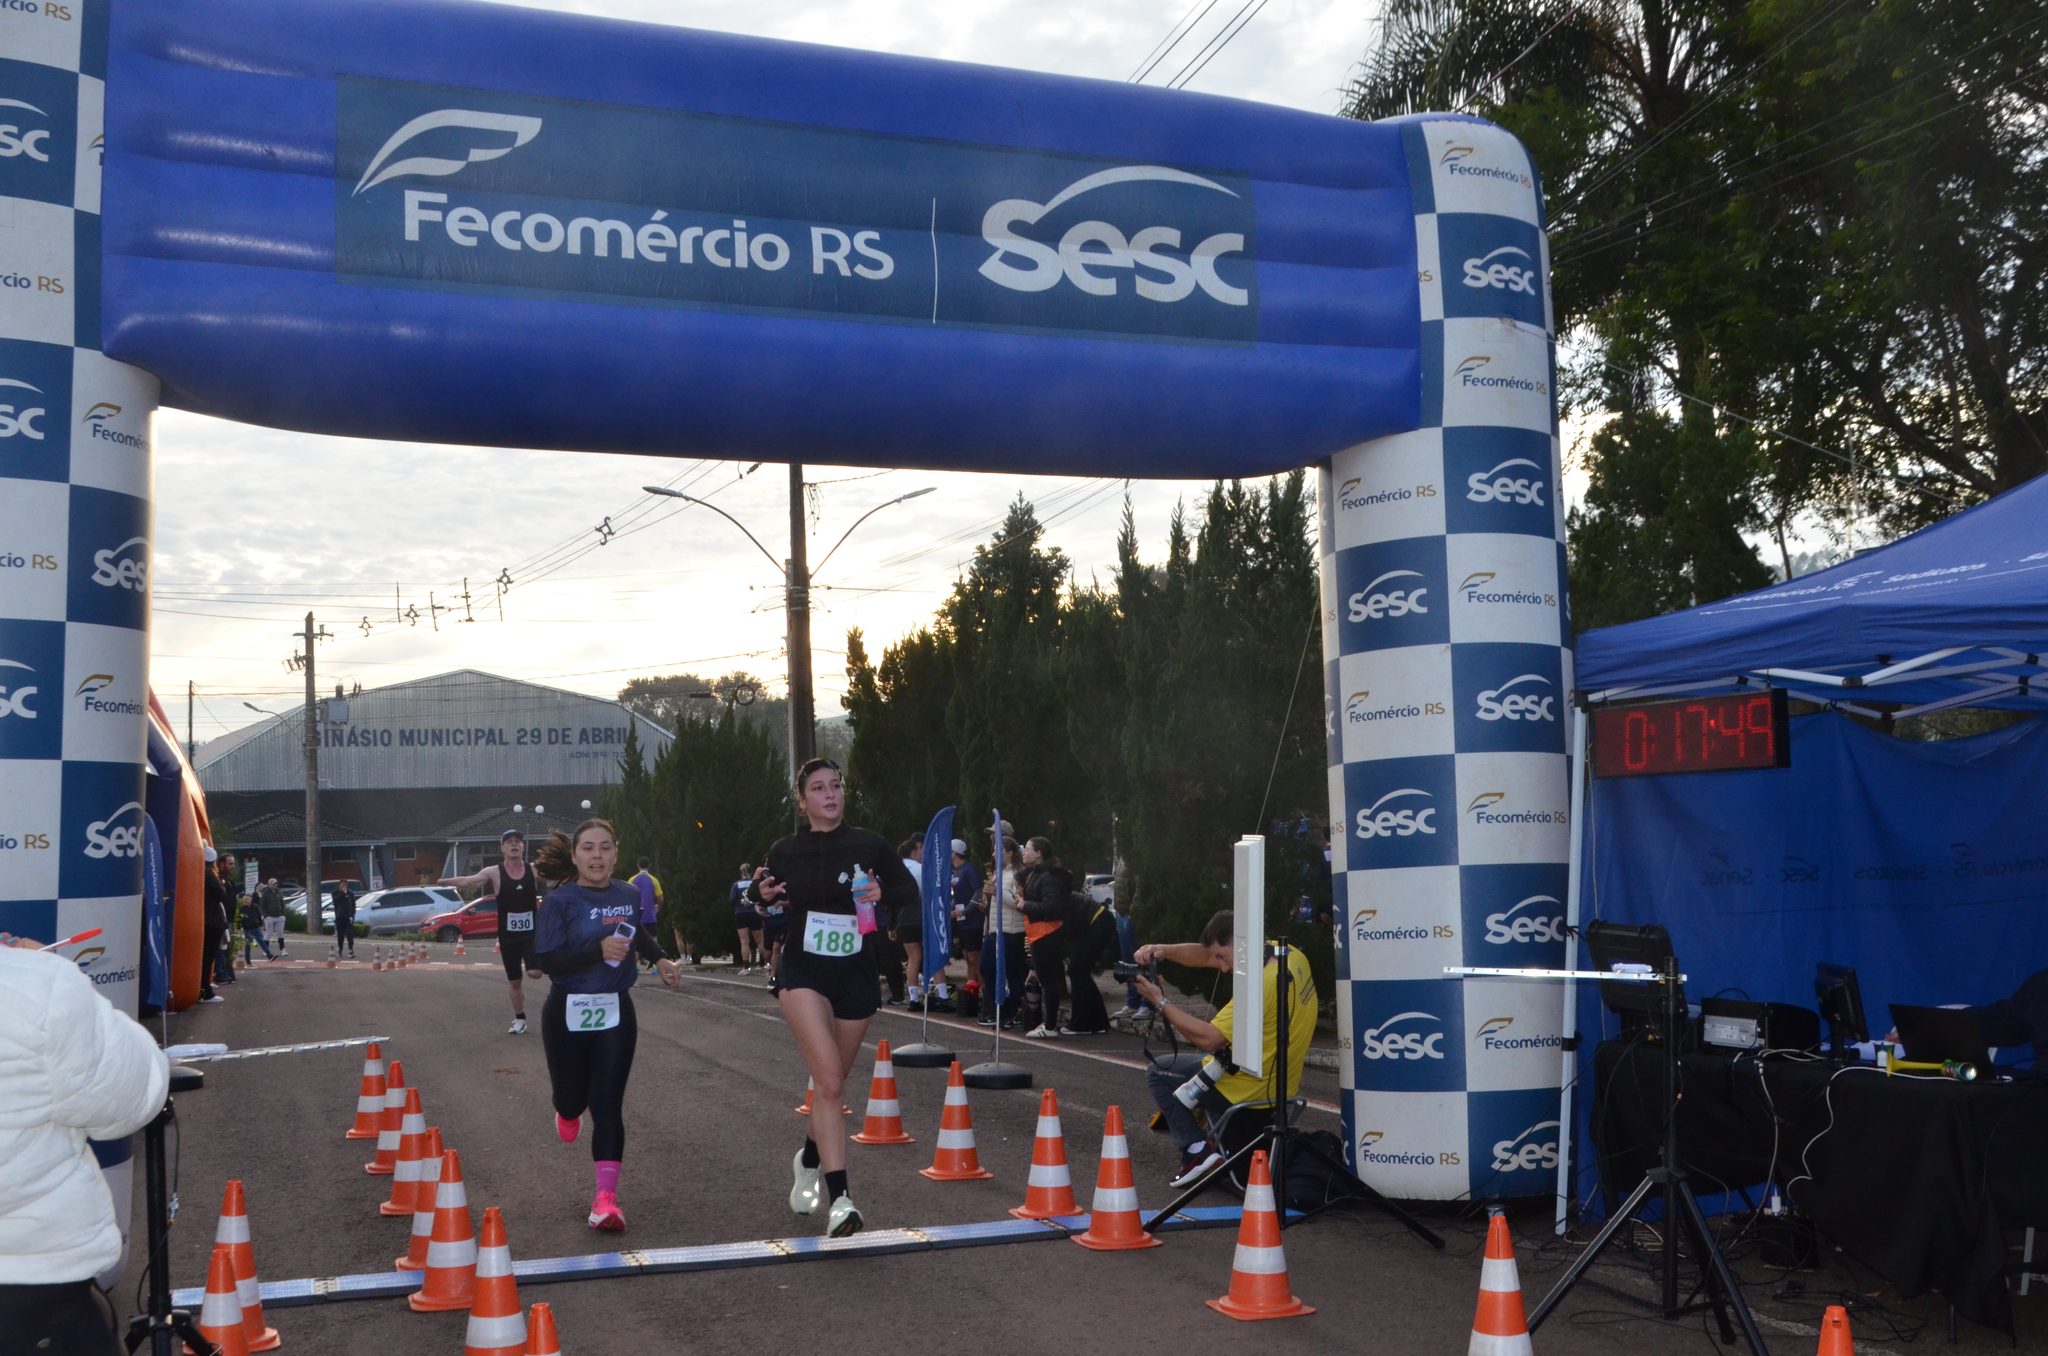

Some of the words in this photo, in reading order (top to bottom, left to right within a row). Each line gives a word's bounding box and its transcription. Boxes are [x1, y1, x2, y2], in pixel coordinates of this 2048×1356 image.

[44, 2, 72, 21] RS
[1450, 163, 1519, 184] Fecomércio
[1520, 175, 1532, 190] RS
[404, 189, 790, 272] Fecomércio
[811, 226, 895, 280] RS
[977, 165, 1249, 305] Sesc
[1462, 246, 1535, 296] Sesc
[0, 272, 31, 289] cio
[38, 275, 65, 294] RS
[1463, 374, 1534, 393] Fecomércio
[1536, 379, 1548, 395] RS
[1466, 457, 1545, 506] Sesc
[1342, 480, 1411, 511] Fecomércio
[1416, 485, 1437, 497] RS
[32, 554, 58, 570] RS
[1348, 570, 1429, 623] Sesc
[1468, 590, 1543, 606] Fecomércio
[1544, 594, 1556, 607] RS
[1475, 674, 1555, 722] Sesc
[1349, 705, 1421, 724] Fecomércio
[1425, 702, 1446, 717] RS
[400, 727, 509, 747] MUNICIPAL
[516, 727, 542, 746] 29
[548, 727, 572, 745] DE
[1624, 697, 1774, 771] 0:17:49
[1356, 788, 1437, 840] Sesc
[1477, 810, 1552, 826] Fecomércio
[1554, 812, 1567, 826] RS
[24, 834, 50, 850] RS
[510, 919, 531, 930] 930
[1357, 926, 1429, 941] Fecomércio
[1433, 926, 1454, 939] RS
[813, 929, 855, 954] 188
[580, 1008, 606, 1029] 22
[1363, 1011, 1445, 1060] Sesc
[1485, 1034, 1562, 1050] Fecomércio
[1364, 1149, 1435, 1166] Fecomércio
[1439, 1152, 1460, 1166] RS
